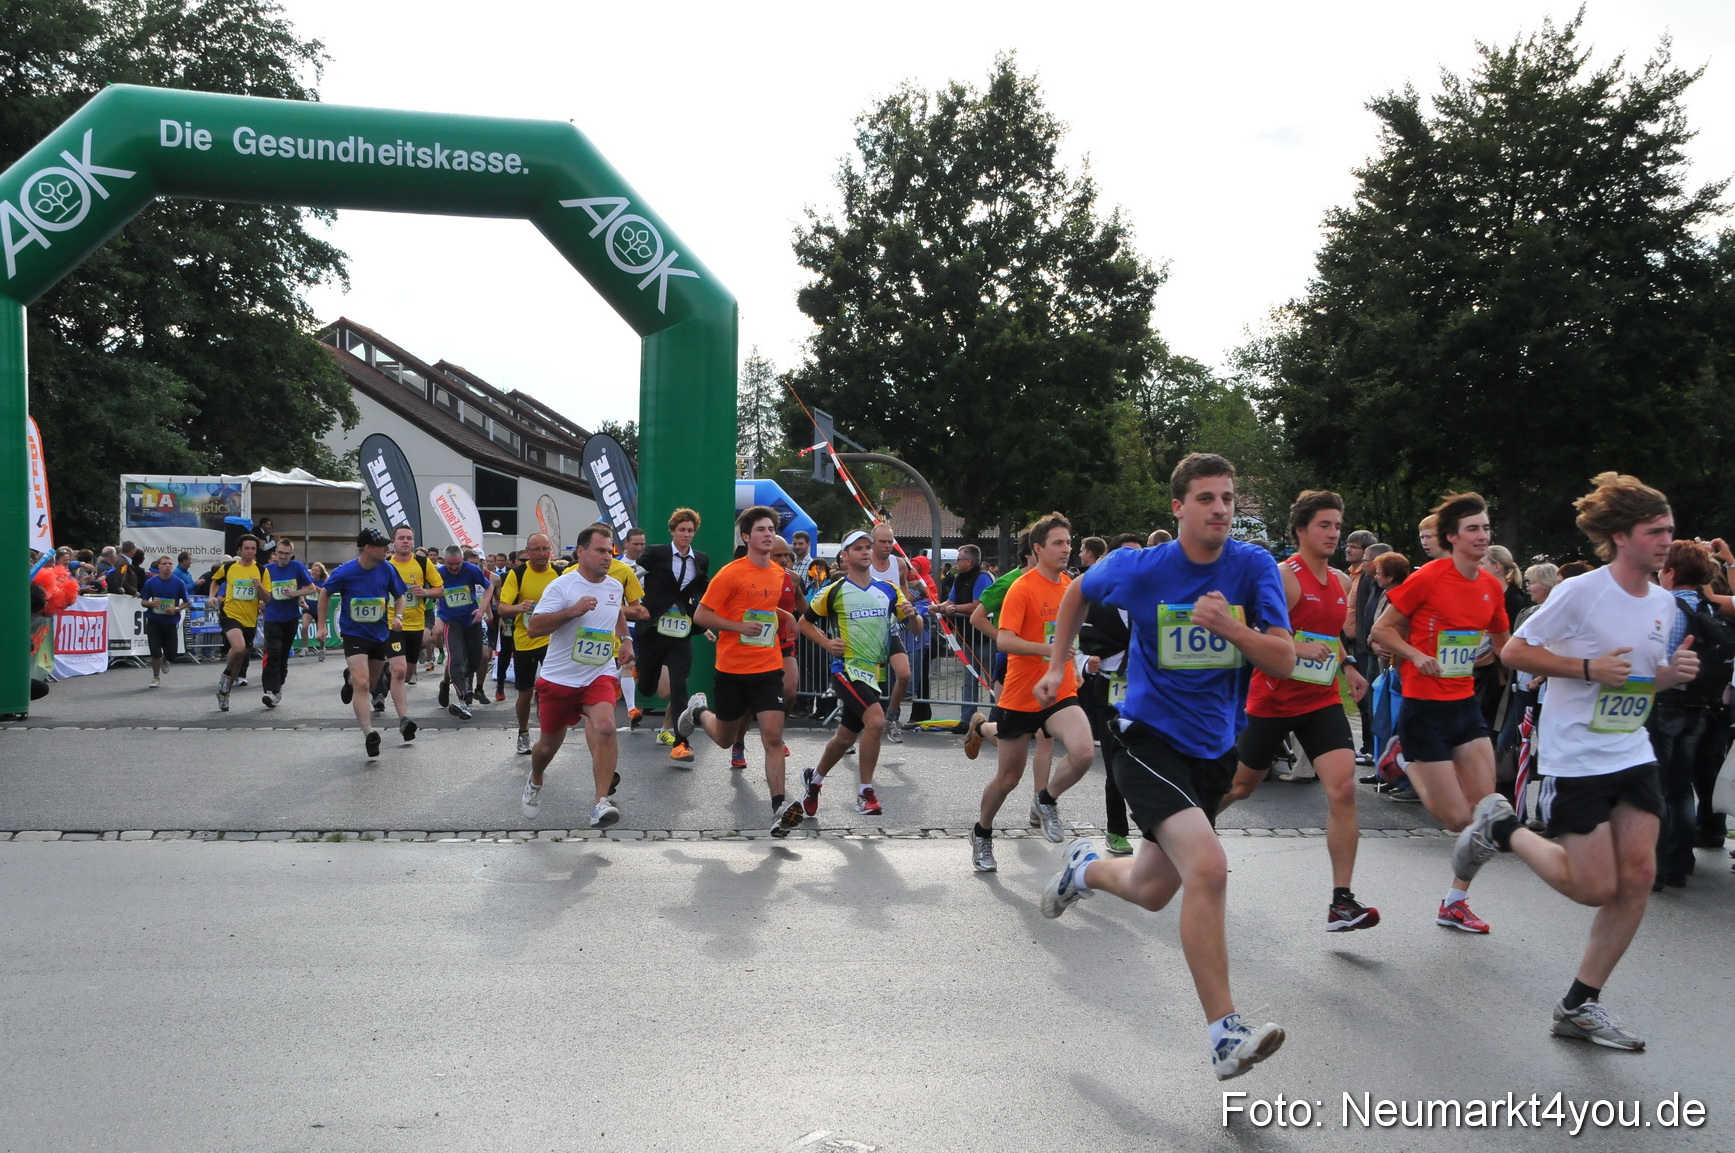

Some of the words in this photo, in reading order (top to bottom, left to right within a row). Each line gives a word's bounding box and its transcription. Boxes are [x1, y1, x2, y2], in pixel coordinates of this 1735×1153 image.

[160, 119, 212, 150] Die
[233, 126, 529, 174] Gesundheitskasse.
[0, 128, 137, 280] AOK
[558, 197, 700, 315] AOK
[131, 493, 174, 508] TLA
[180, 501, 231, 515] Logistics
[143, 545, 222, 555] www.tla-gmbh.de
[236, 587, 254, 596] 778
[275, 586, 292, 595] 16
[448, 592, 467, 603] 172
[354, 606, 377, 617] 161
[851, 608, 886, 619] BOCK
[660, 617, 687, 631] 1115
[58, 615, 104, 651] MEIER
[1169, 626, 1227, 653] 166
[576, 640, 611, 657] 1215
[1440, 648, 1477, 665] 1104
[1600, 695, 1648, 717] 1209
